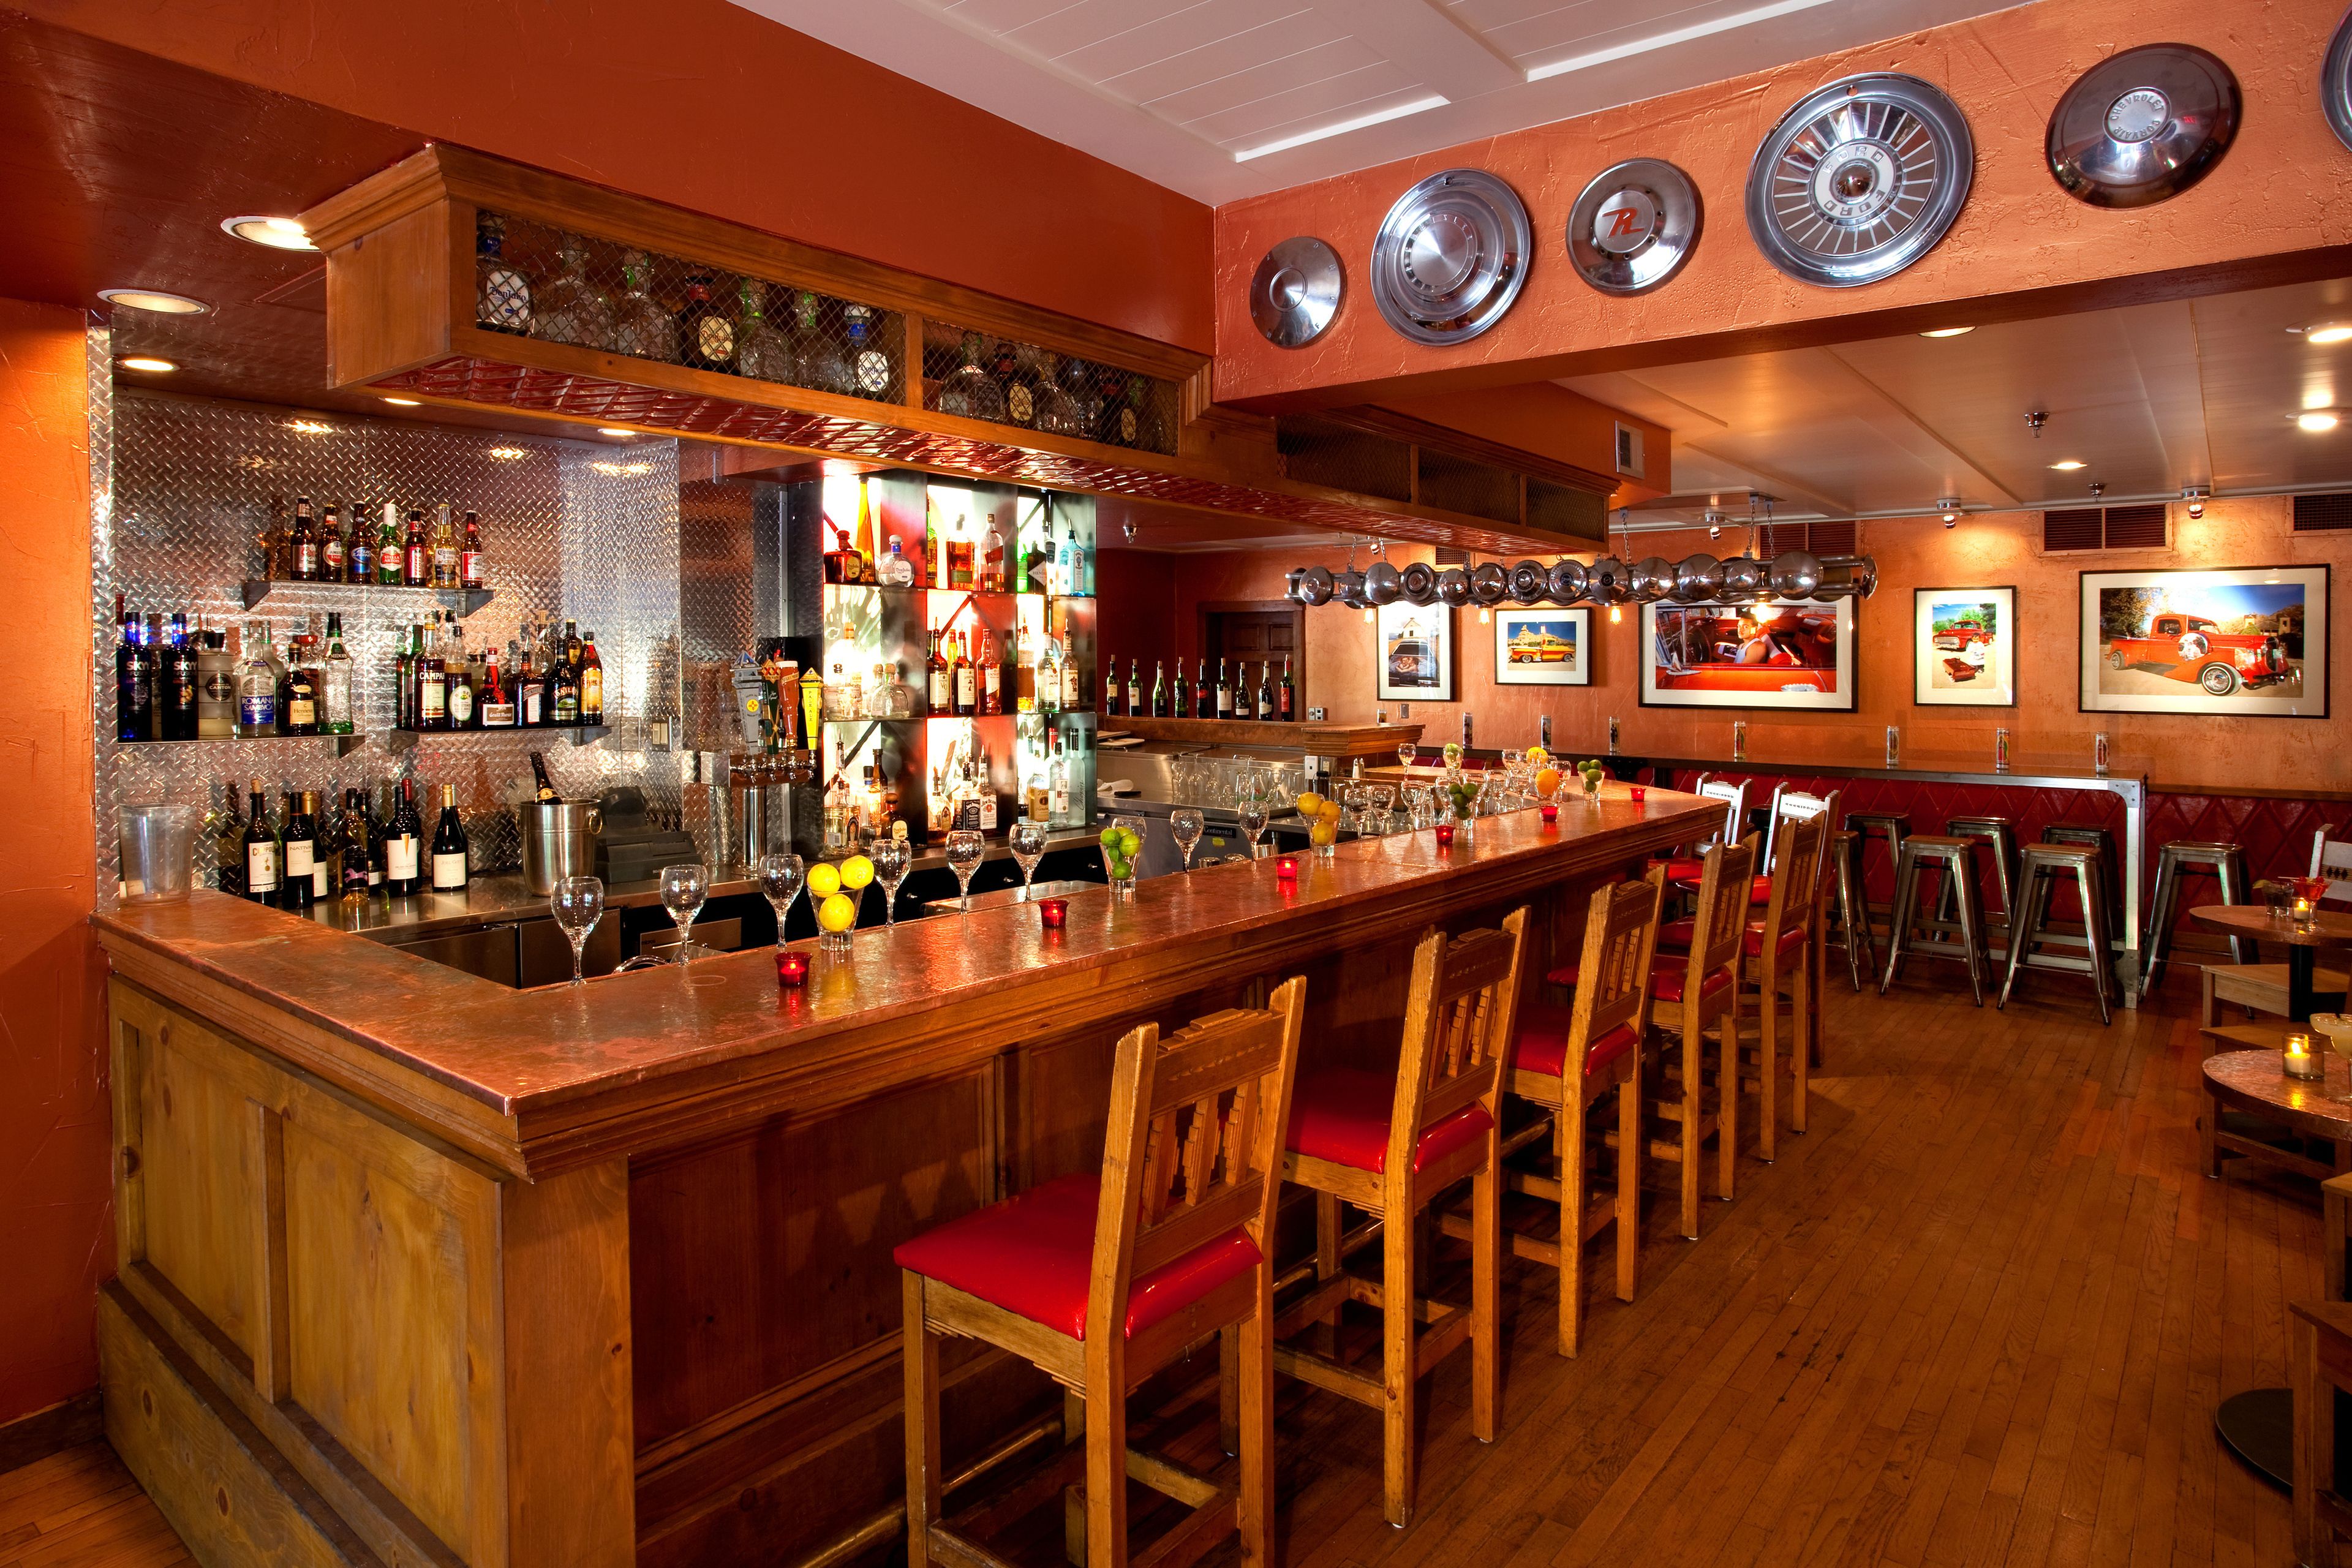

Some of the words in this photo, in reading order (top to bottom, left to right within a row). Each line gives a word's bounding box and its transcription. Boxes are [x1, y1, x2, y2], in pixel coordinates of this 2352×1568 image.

[2111, 94, 2165, 120] CHEVROLET
[2114, 120, 2161, 140] CORVAIR
[1823, 146, 1885, 175] FORD
[1823, 189, 1886, 216] FORD
[1601, 206, 1645, 239] R
[126, 660, 149, 671] SKYY
[173, 660, 197, 671] SKYY
[419, 671, 445, 680] CAMPA
